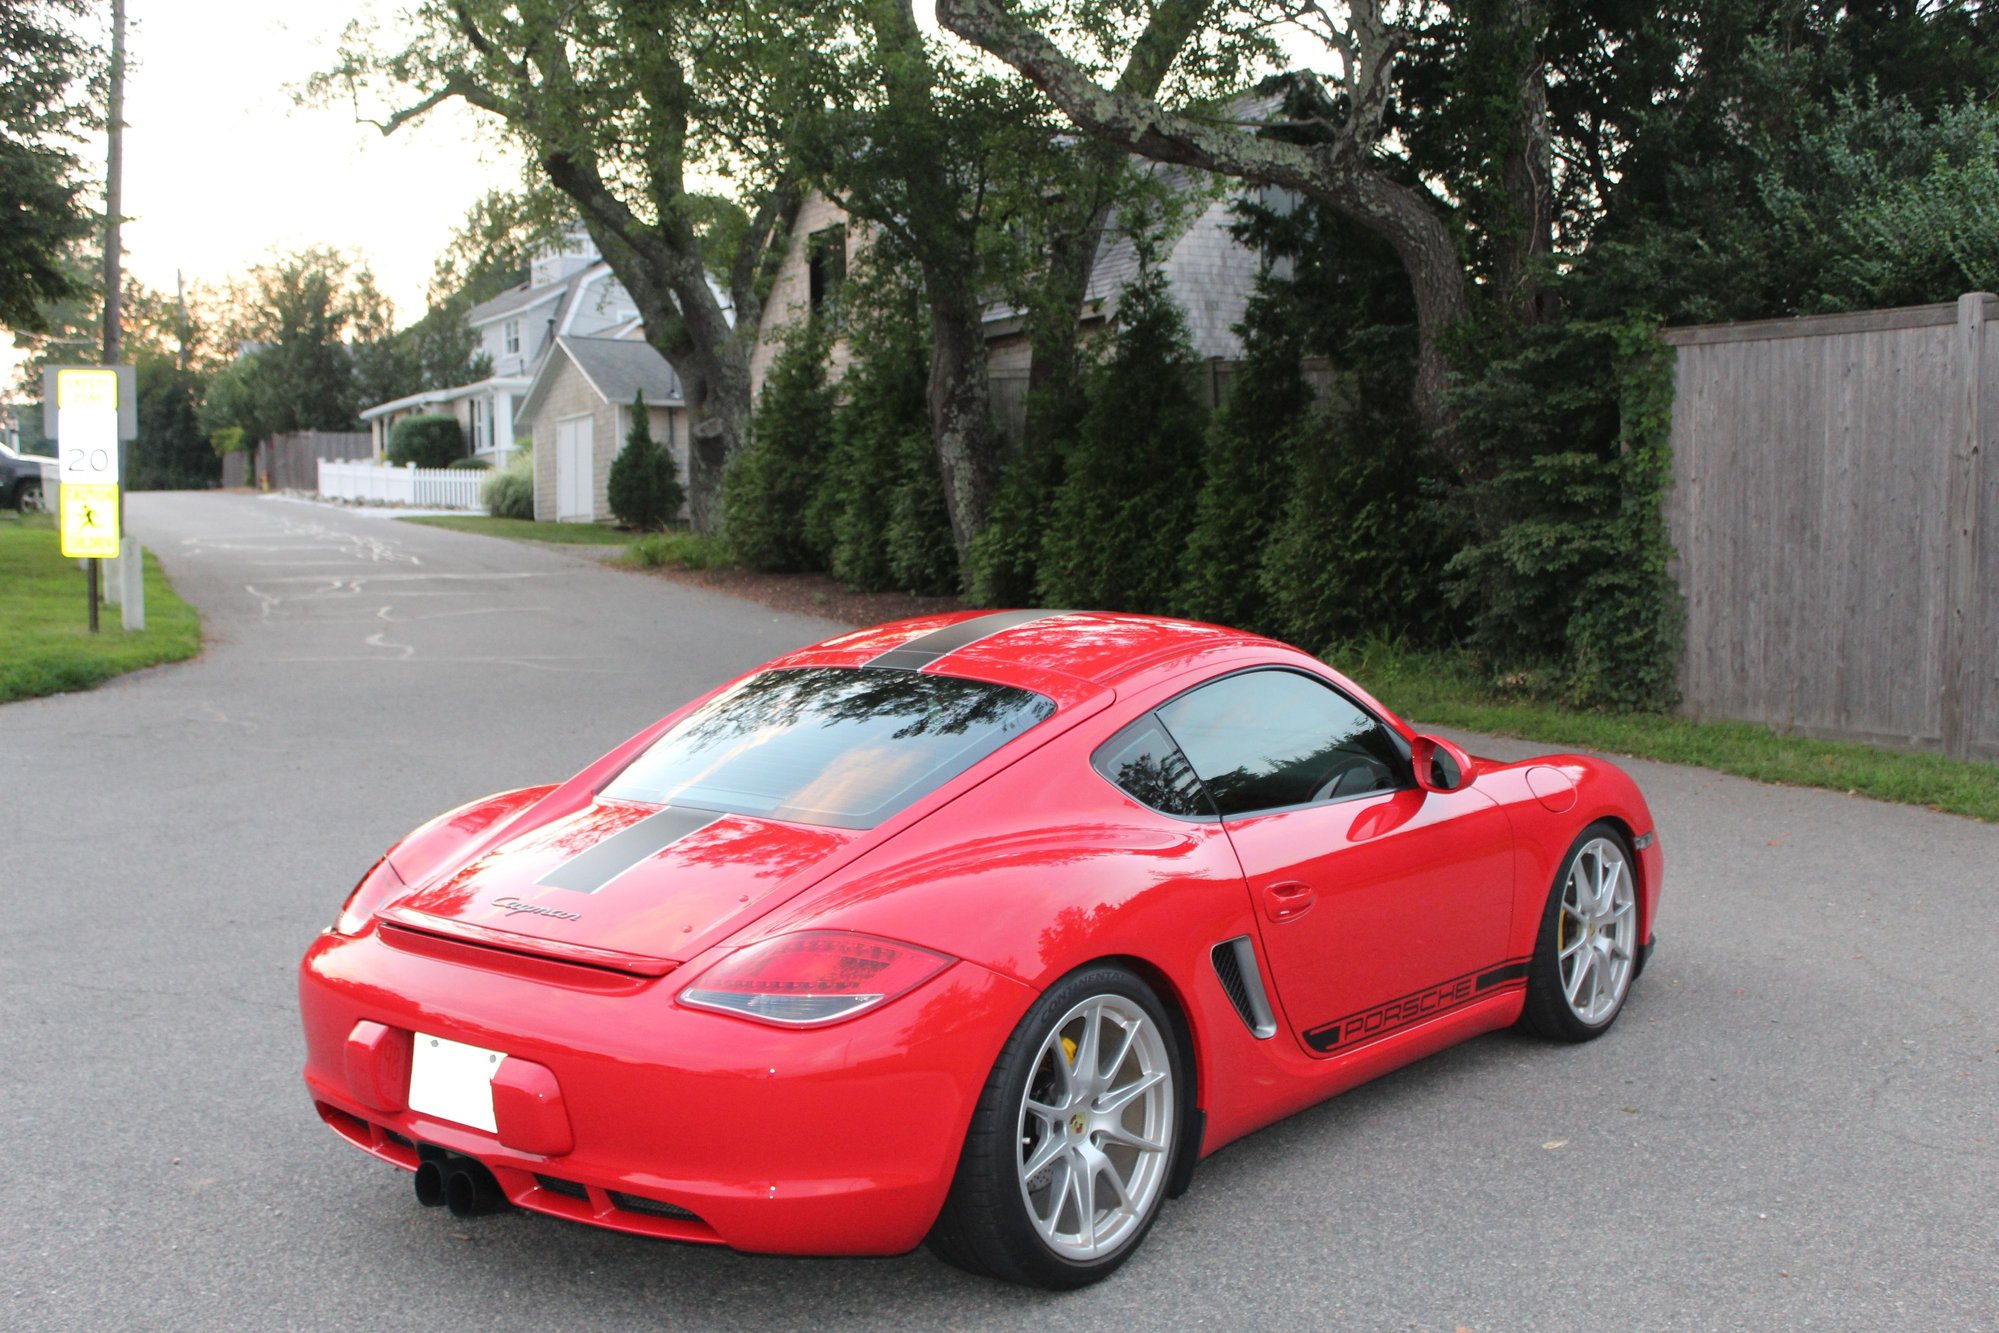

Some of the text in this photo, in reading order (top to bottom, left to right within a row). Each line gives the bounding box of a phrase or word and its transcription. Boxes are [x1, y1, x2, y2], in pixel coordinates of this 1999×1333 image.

[68, 448, 109, 472] 20
[491, 896, 582, 922] Cayman
[1344, 977, 1472, 1040] PORSCHE
